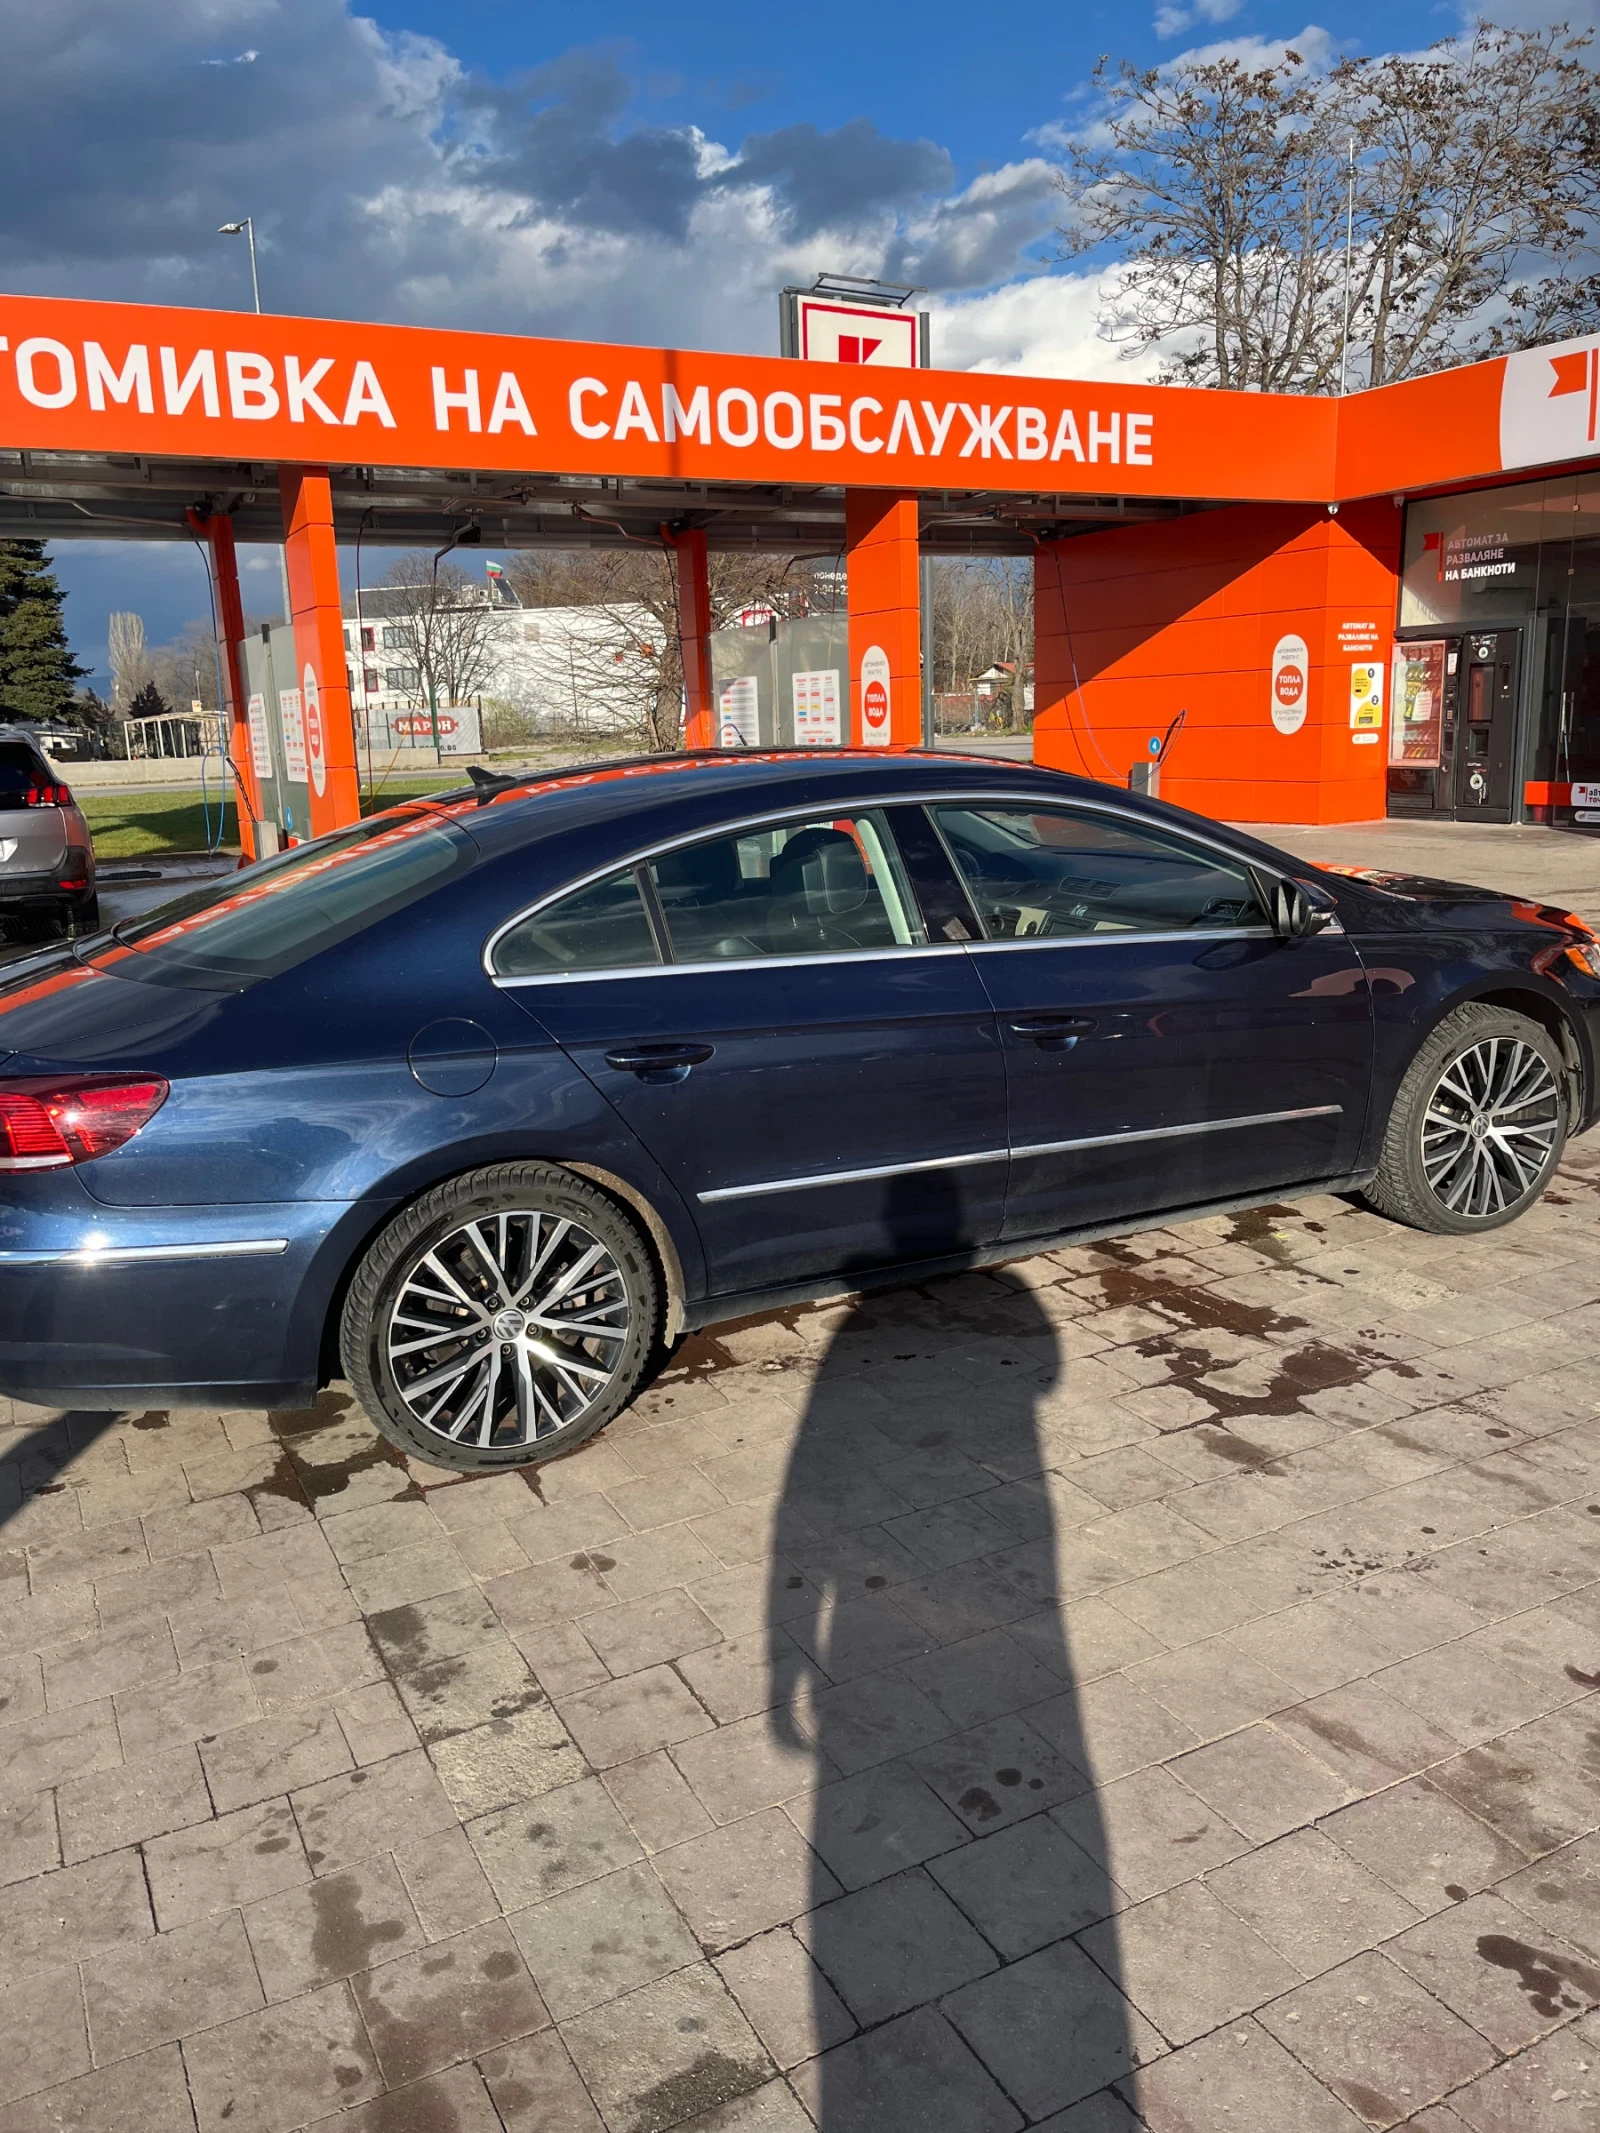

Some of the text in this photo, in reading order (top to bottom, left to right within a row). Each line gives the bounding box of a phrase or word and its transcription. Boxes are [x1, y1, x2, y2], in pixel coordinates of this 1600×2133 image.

[0, 335, 1154, 465] ОМИВКА НА САМООБСЛУЖВАНЕ
[1447, 532, 1509, 550] АВТОМАТ ЗА
[1446, 548, 1504, 565] РАЗВАЛЯНЕ
[1445, 562, 1516, 581] НА БАНКНОТИ
[1342, 644, 1373, 652] БАНКНОТИ
[1278, 675, 1301, 684] ТОПЛА
[1279, 687, 1299, 696] ВОДА
[866, 693, 886, 703] ТОПЛА
[868, 707, 884, 718] ВОДА
